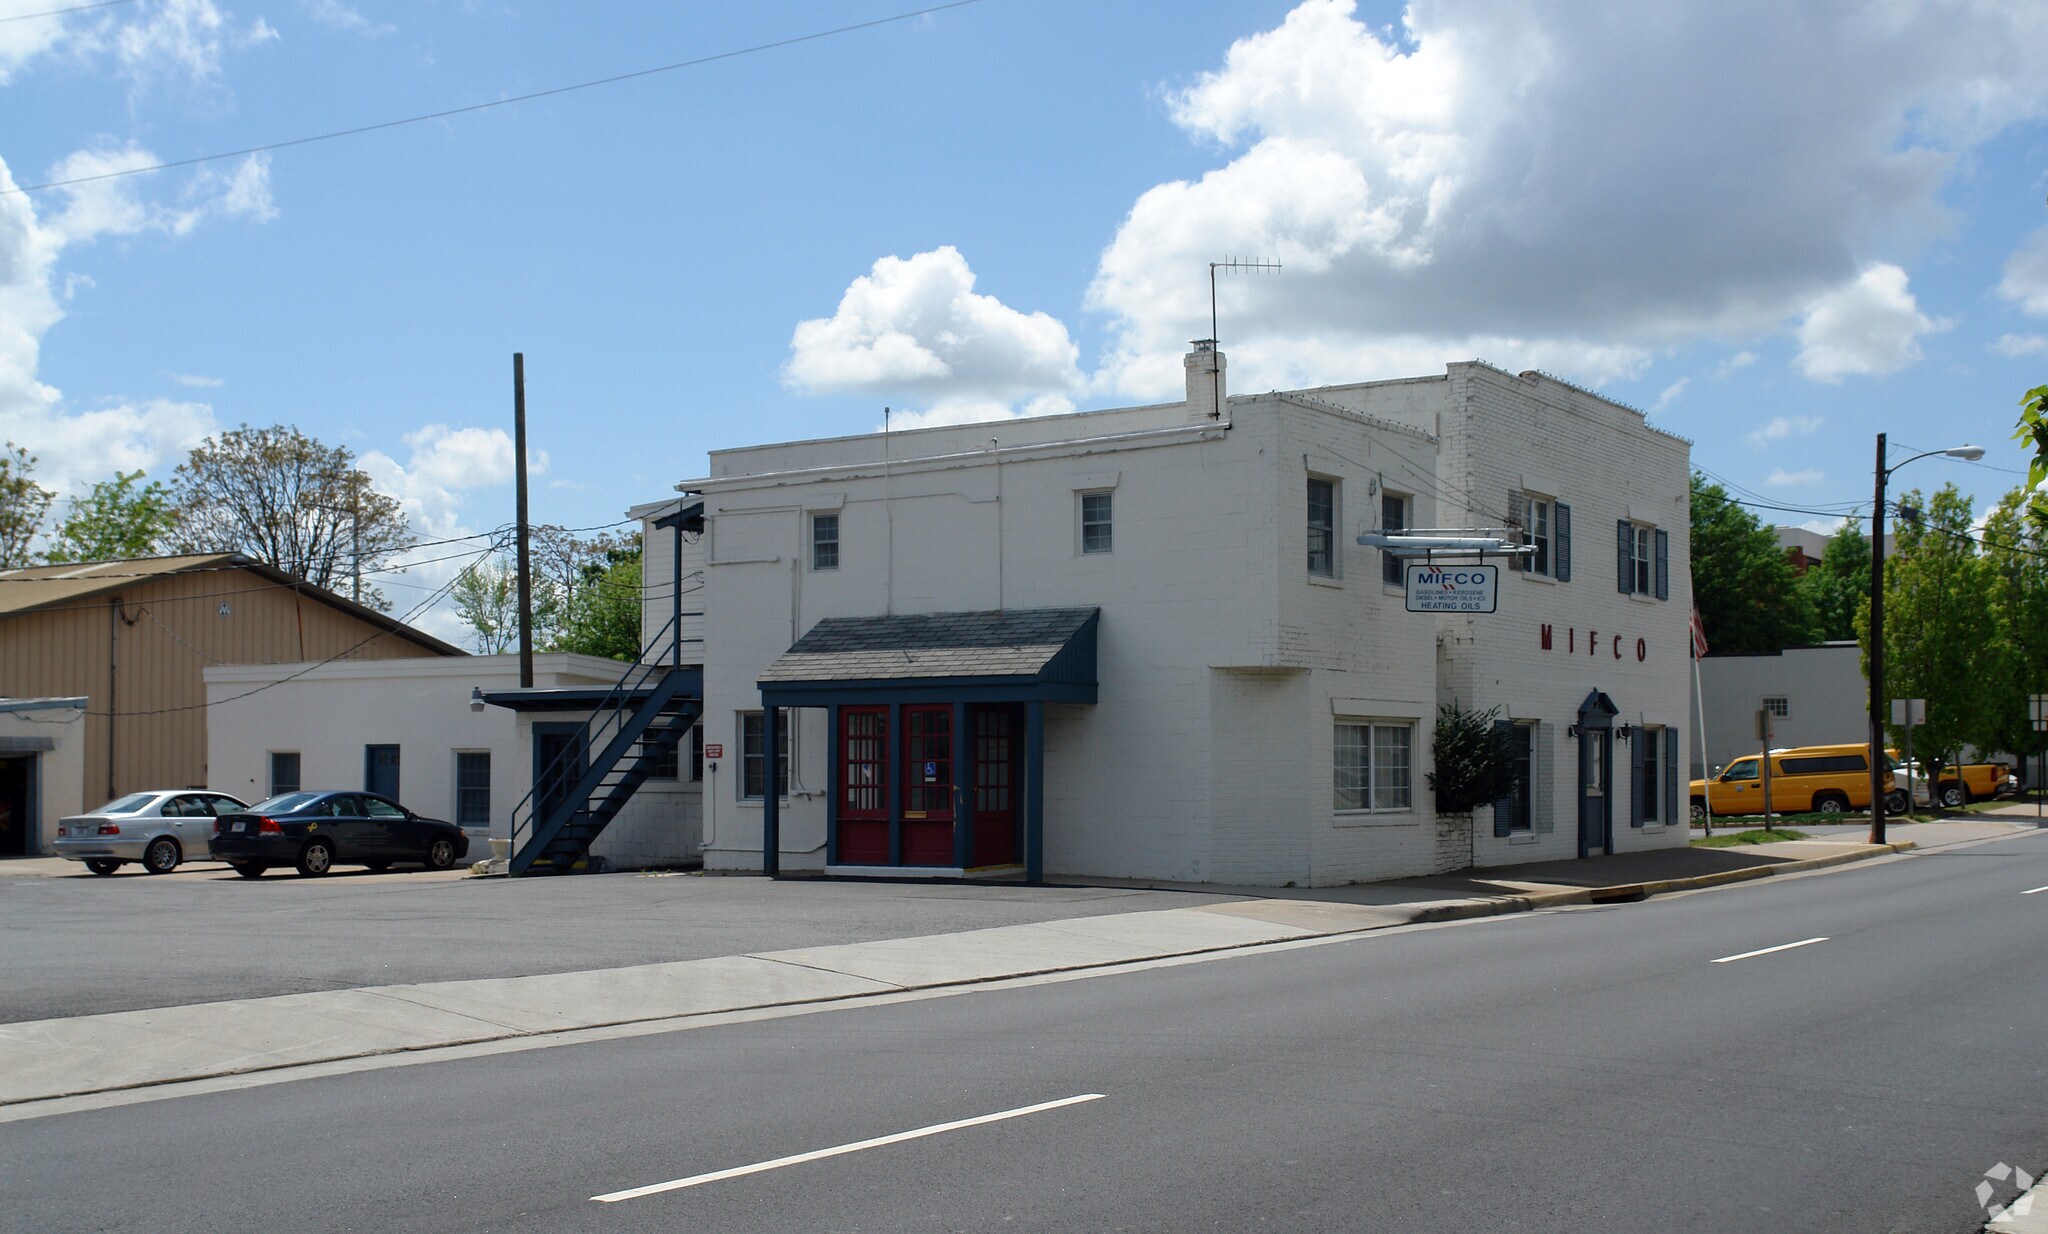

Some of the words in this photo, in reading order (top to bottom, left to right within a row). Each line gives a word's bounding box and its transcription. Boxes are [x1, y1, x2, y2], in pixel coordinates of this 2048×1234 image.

[1418, 573, 1485, 585] MIFCO
[1461, 602, 1481, 610] OILS
[1541, 623, 1646, 662] MIFCO
